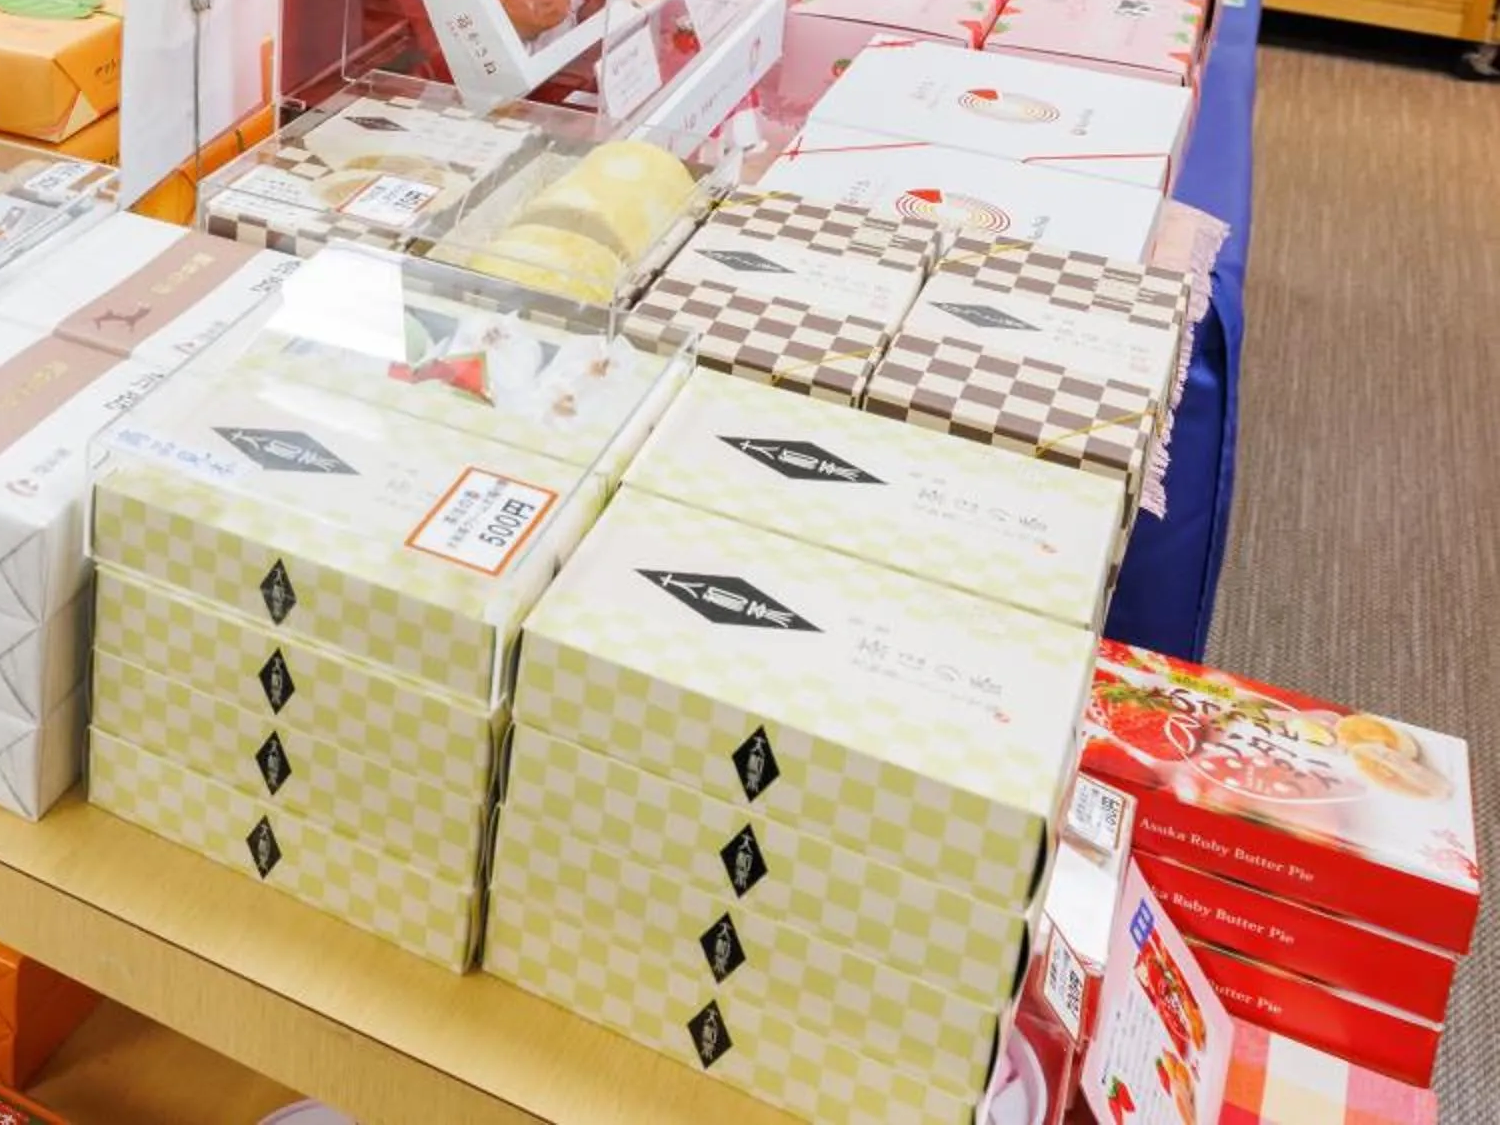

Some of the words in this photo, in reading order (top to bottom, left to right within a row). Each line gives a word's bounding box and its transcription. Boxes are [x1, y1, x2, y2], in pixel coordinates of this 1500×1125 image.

[478, 498, 536, 547] 500円
[1139, 816, 1187, 842] Asuka
[1190, 833, 1229, 856] Ruby
[1235, 848, 1285, 872] Butter
[1289, 863, 1315, 882] Pie
[1173, 891, 1212, 917] Ruby
[1216, 908, 1266, 935] Butter
[1269, 926, 1295, 945] Pie
[1209, 979, 1254, 1004] utter
[1257, 996, 1284, 1015] Pie
